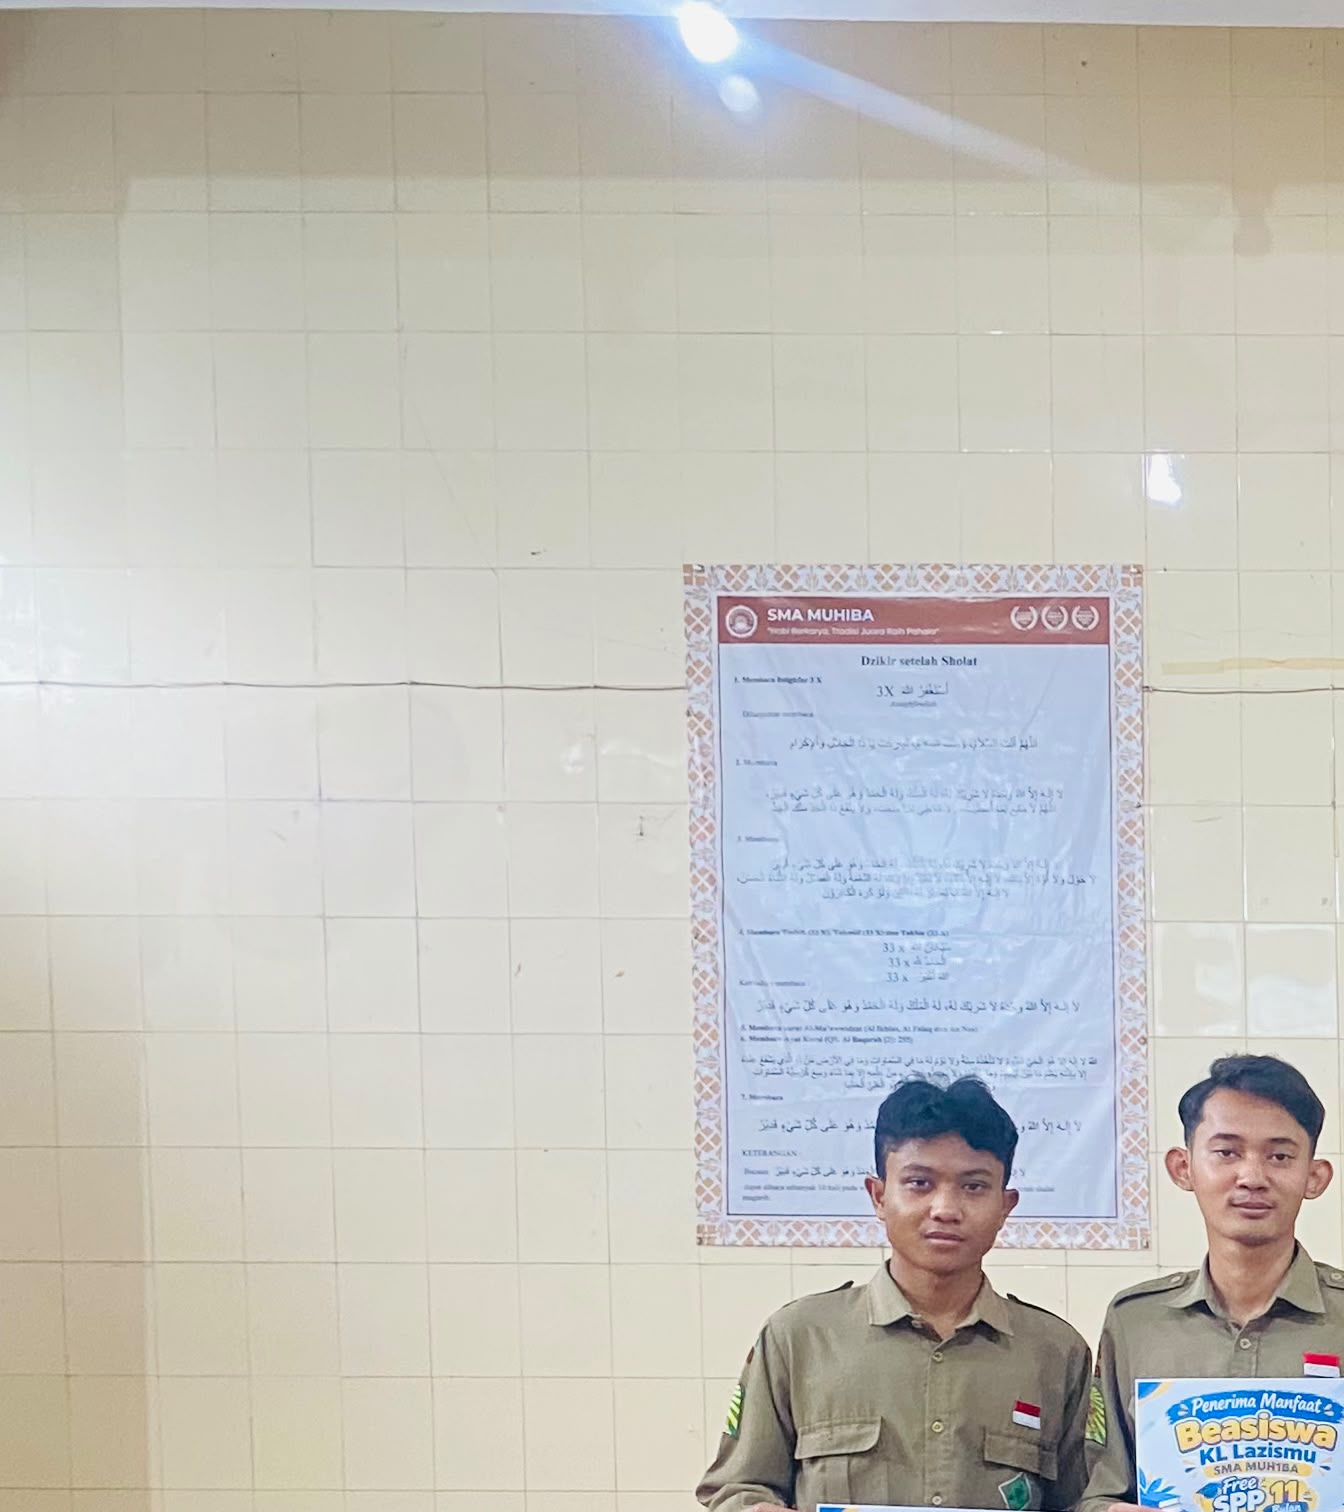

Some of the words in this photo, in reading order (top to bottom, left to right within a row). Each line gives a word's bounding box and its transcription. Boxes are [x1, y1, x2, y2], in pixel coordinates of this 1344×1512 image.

[767, 609, 804, 621] SMA
[861, 656, 896, 666] Dzikir
[900, 656, 938, 666] setelah
[941, 656, 977, 666] Sholat
[1192, 1396, 1256, 1416] Penerima
[1260, 1393, 1322, 1414] Manfaat
[1174, 1413, 1338, 1452] Beasiswa
[1200, 1446, 1228, 1465] KL
[1233, 1443, 1316, 1463] Lazismu
[1214, 1463, 1241, 1476] SMA
[1222, 1476, 1257, 1493] Free
[1269, 1480, 1299, 1504] 11
